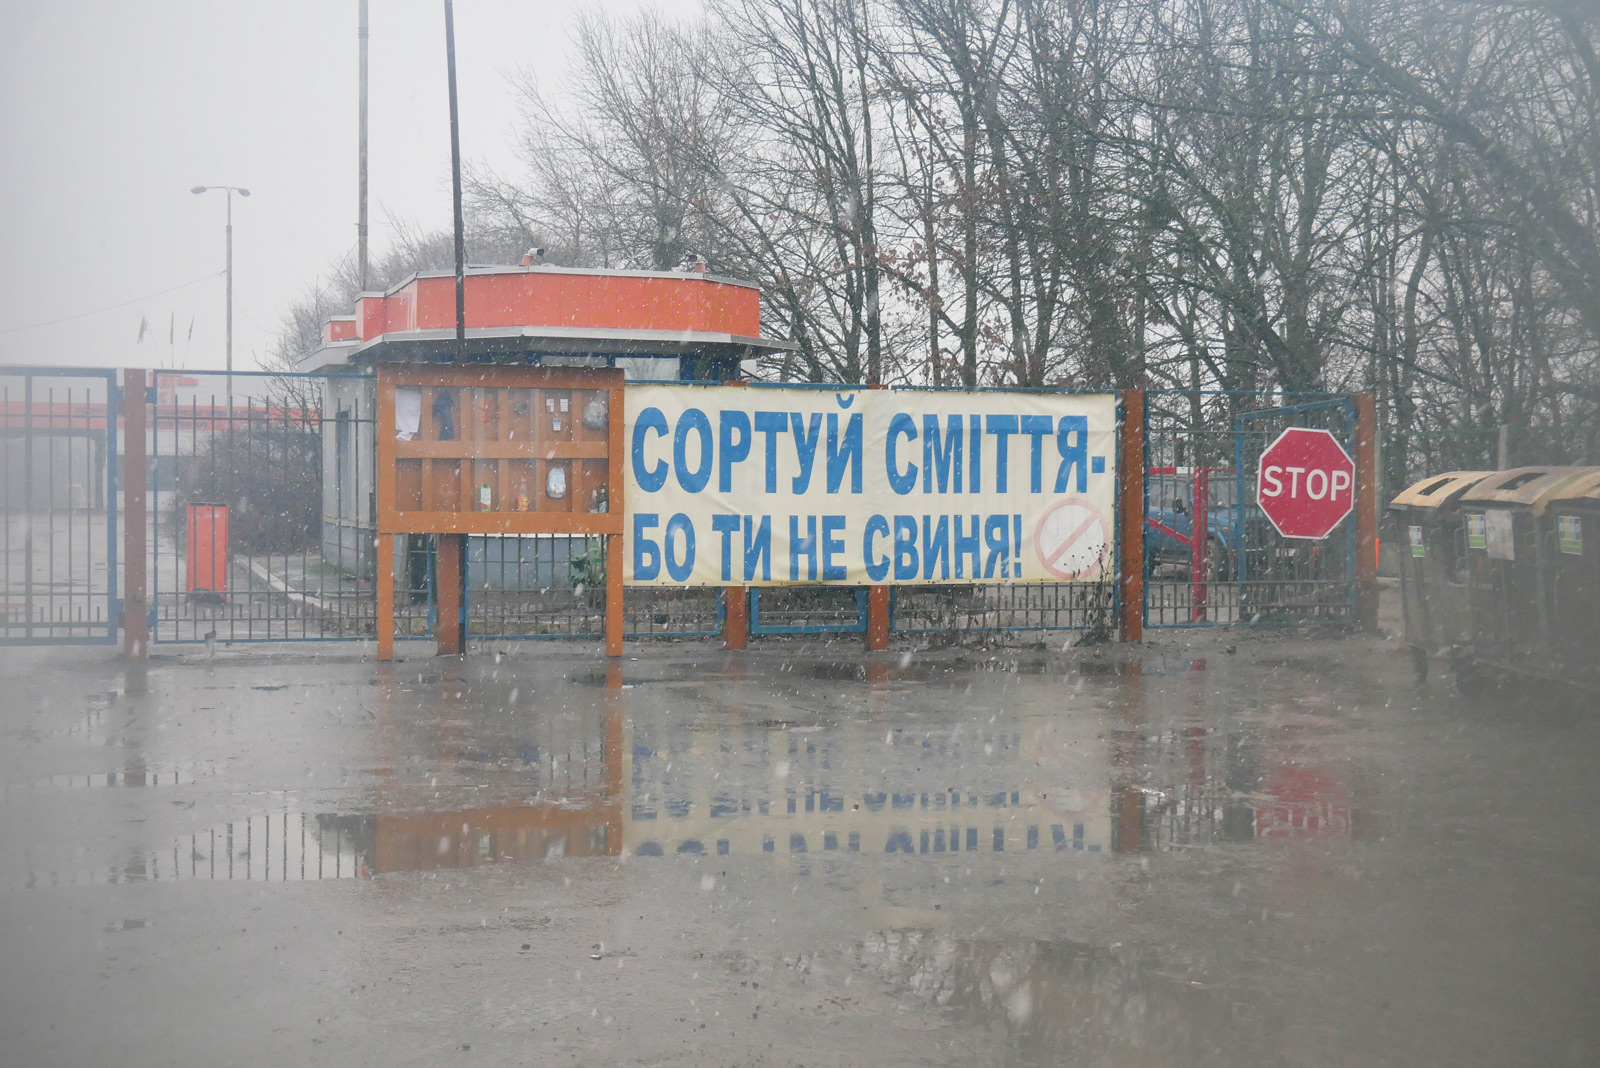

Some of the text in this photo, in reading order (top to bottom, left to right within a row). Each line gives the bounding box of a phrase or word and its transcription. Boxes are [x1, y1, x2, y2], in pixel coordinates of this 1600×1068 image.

[632, 394, 1105, 495] СОРТУЙ СМІТТЯ-
[1262, 465, 1350, 501] STOP
[633, 513, 1022, 582] БО ТИ НЕ СВИНЯ!
